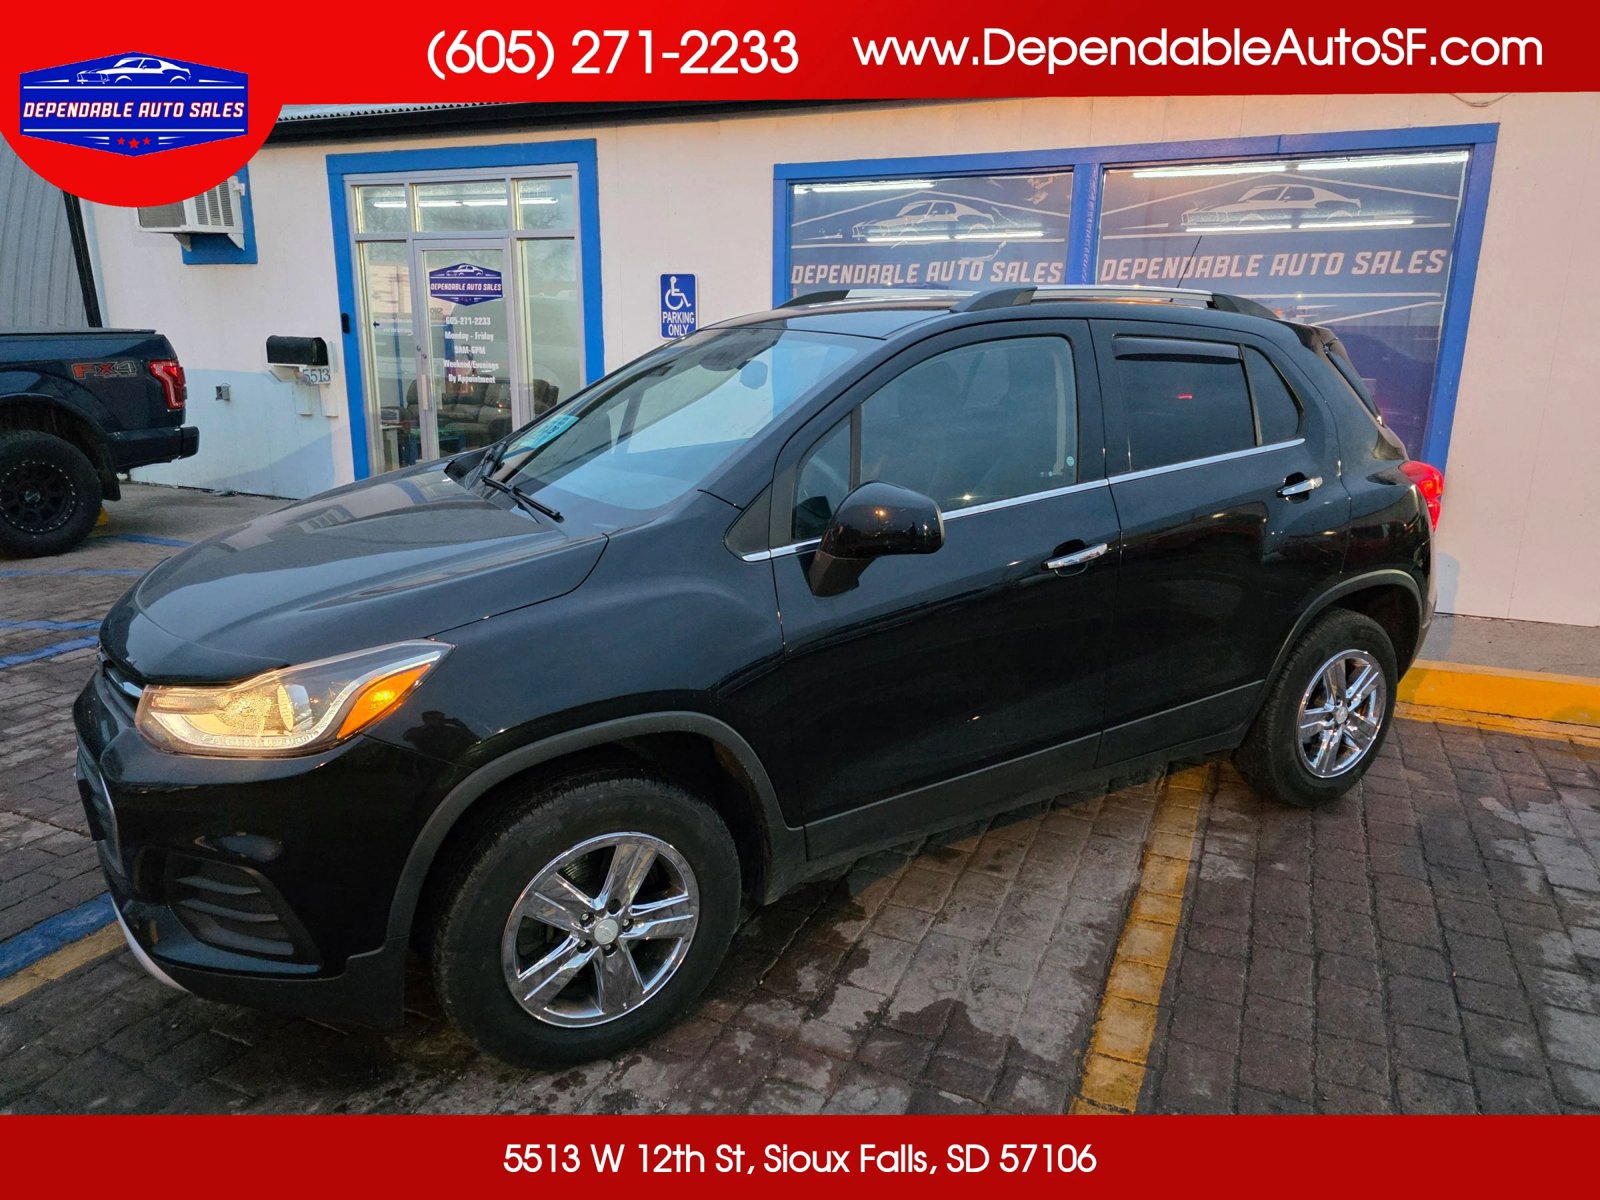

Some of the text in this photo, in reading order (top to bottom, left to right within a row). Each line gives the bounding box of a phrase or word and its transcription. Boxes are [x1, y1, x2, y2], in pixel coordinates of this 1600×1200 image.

[790, 260, 1064, 284] DEPENDABLE AUTO SALES
[1100, 249, 1447, 282] DEPENDABLE AUTO SALES
[430, 283, 502, 291] DEPENDABLE AUTO SALES
[445, 316, 491, 326] 605-271-2233
[662, 311, 695, 336] PARKING ONLY
[444, 331, 469, 342] Monday
[474, 331, 494, 342] Friday
[71, 360, 138, 379] FX4
[302, 368, 331, 383] 5513
[448, 373, 496, 384] By Appointment
